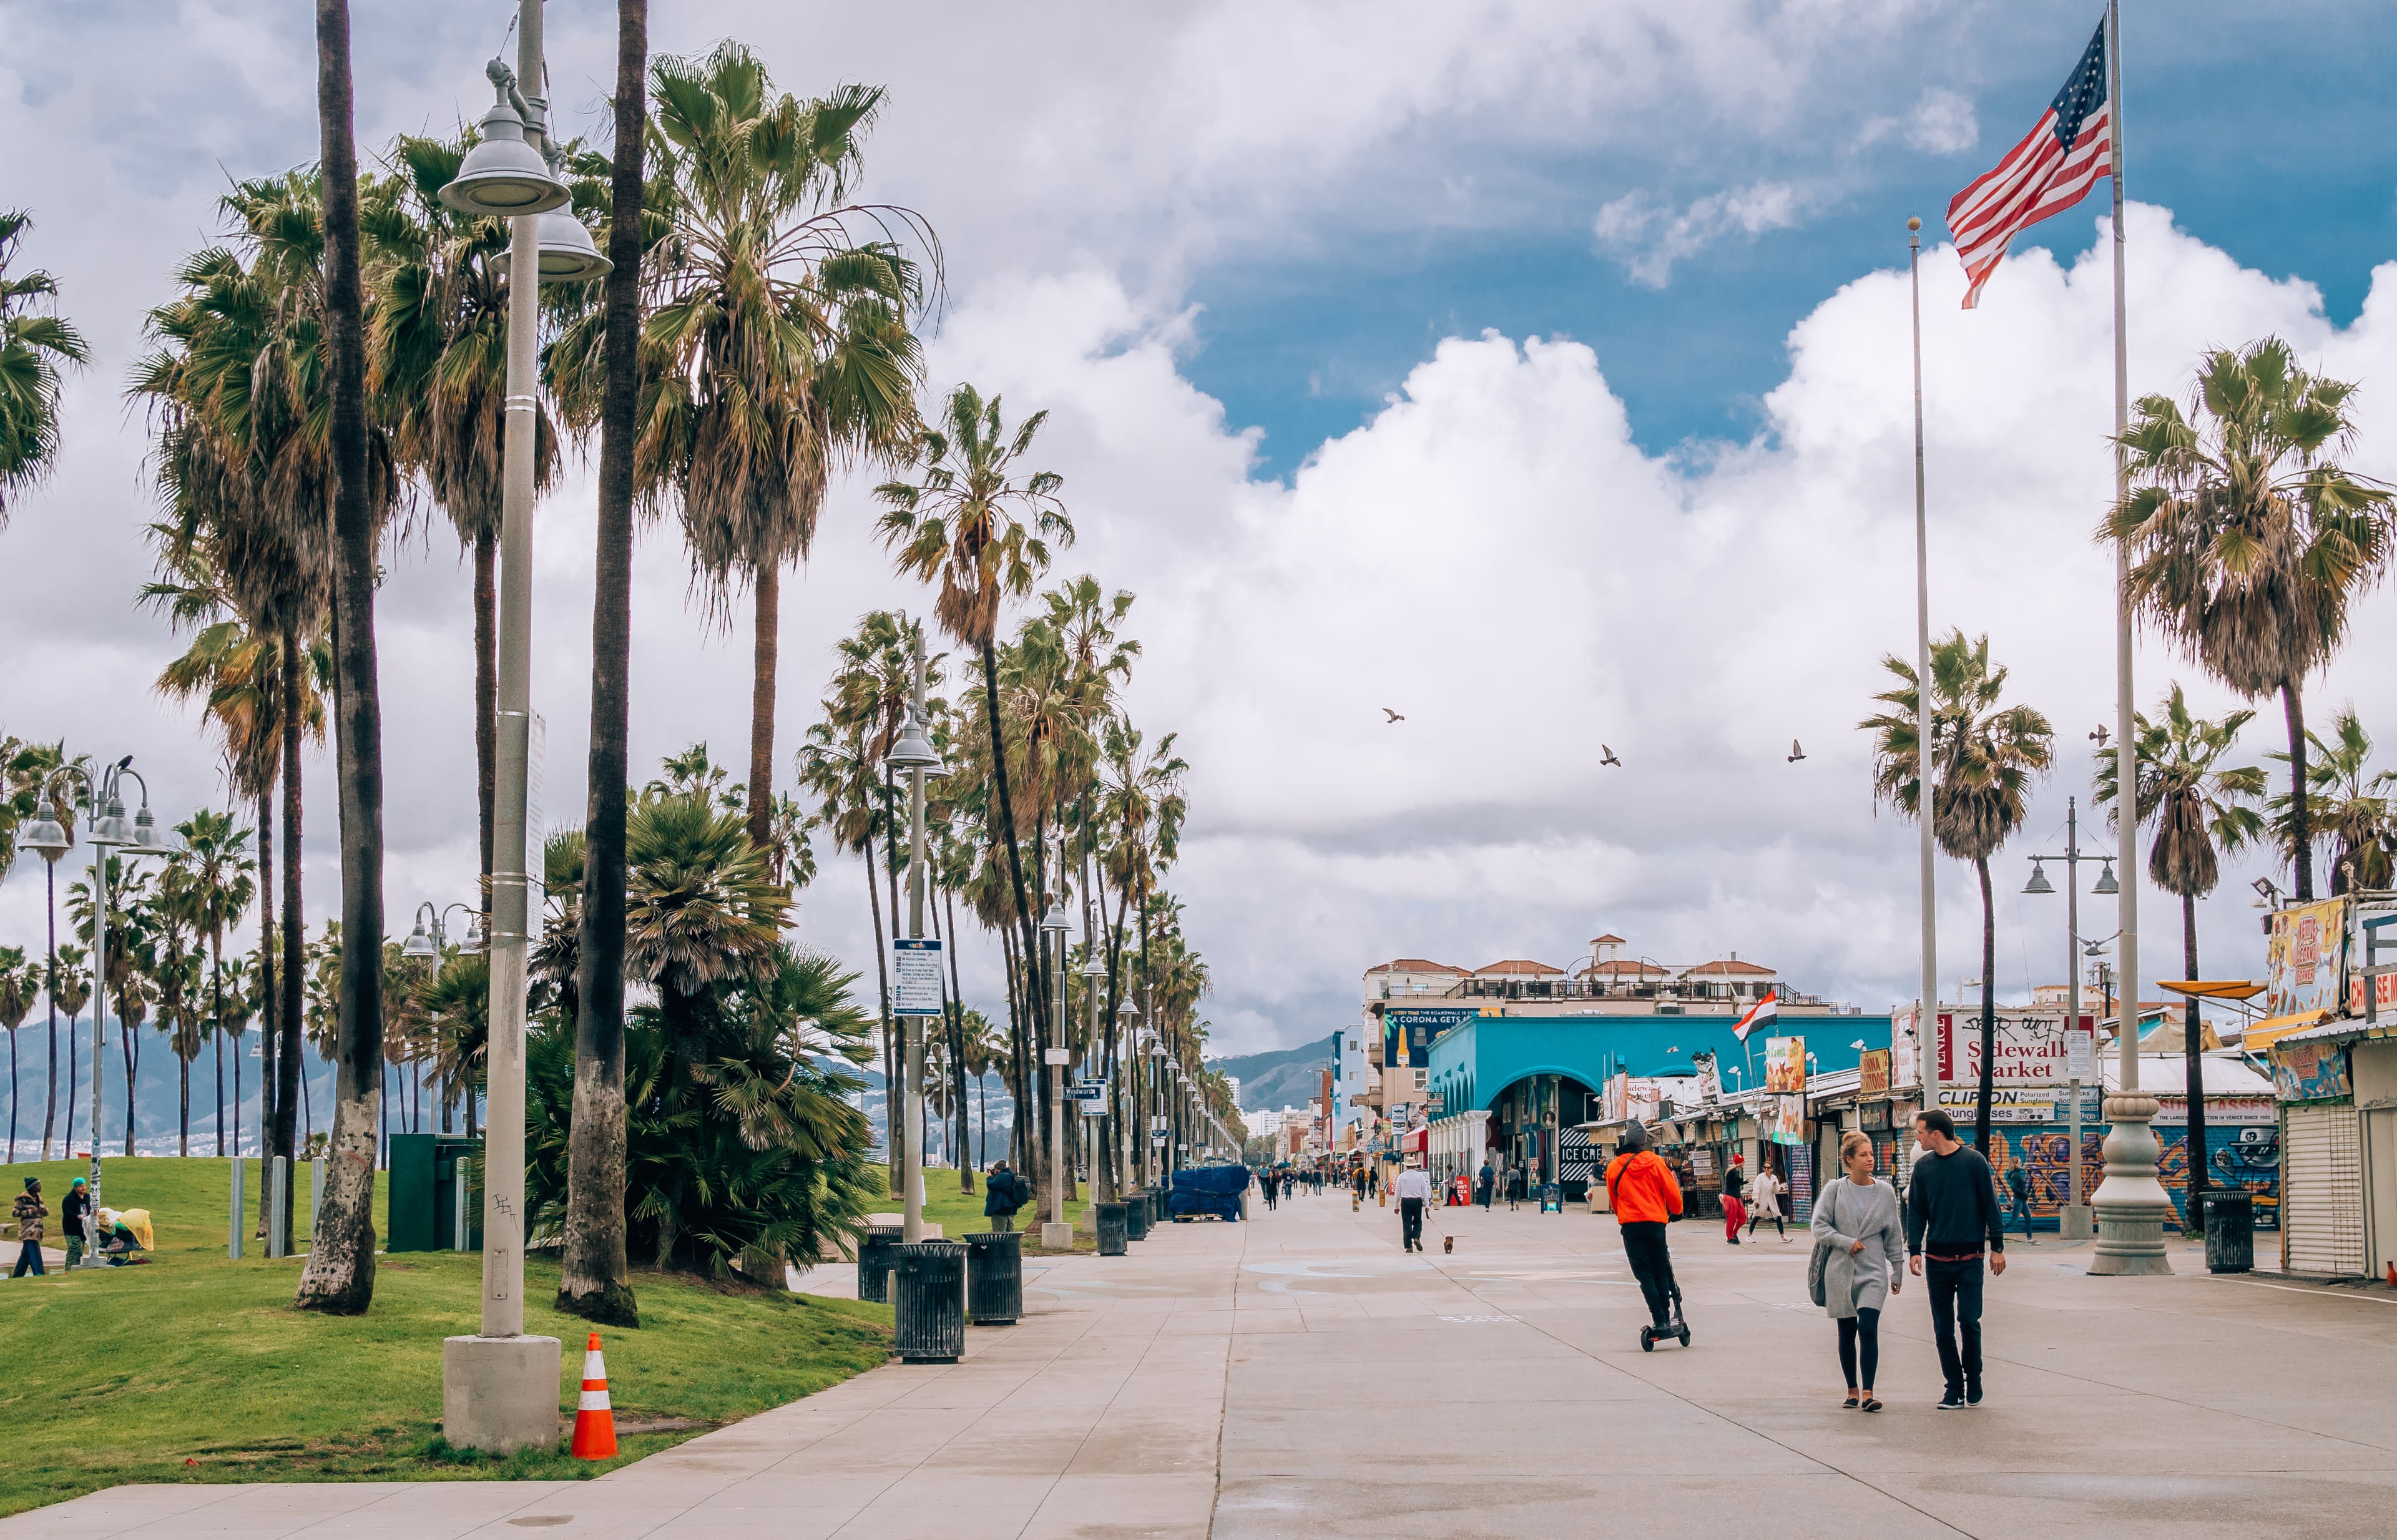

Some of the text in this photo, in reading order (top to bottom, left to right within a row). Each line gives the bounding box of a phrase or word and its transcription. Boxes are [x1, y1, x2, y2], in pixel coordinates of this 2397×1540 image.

[2351, 976, 2388, 1008] CHISE
[1968, 1041, 2068, 1057] Sdewalk
[1939, 1091, 2017, 1105] CLIP ON
[2160, 1099, 2270, 1111] SULASSES
[1944, 1108, 2012, 1120] unglses
[1562, 1149, 1579, 1160] ICE
